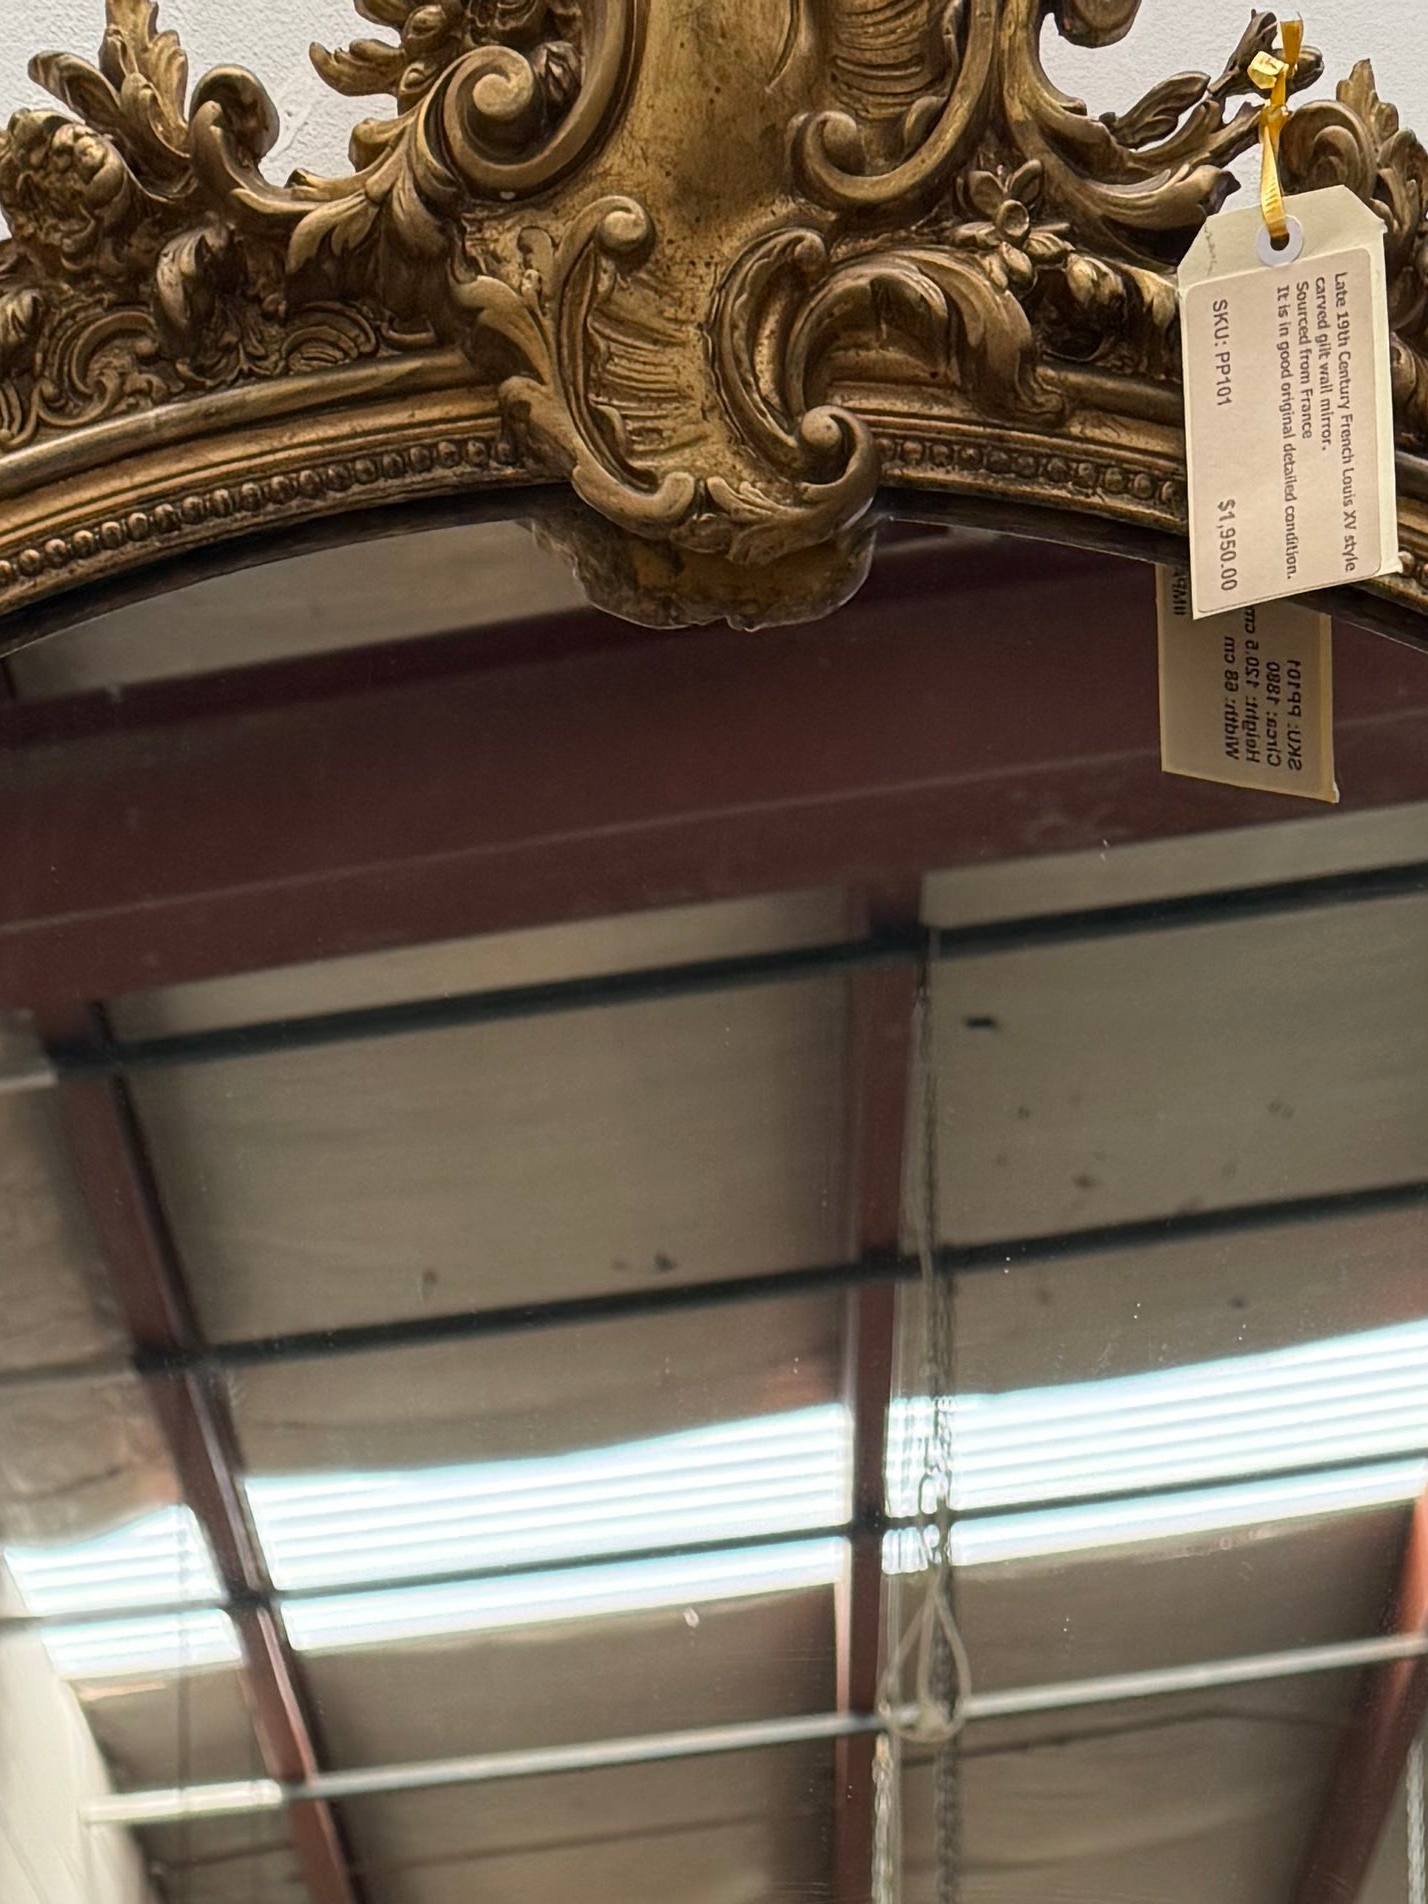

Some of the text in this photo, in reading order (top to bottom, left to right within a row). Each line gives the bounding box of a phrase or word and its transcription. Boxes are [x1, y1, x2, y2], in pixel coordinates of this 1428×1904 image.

[1213, 298, 1232, 406] SKU: PP101
[1277, 285, 1299, 580] It is in good original detailed condition.
[1296, 281, 1313, 439] Sourced from France
[1315, 277, 1334, 451] carved gilt wall mirror.
[1335, 272, 1358, 572] Late 19th Century French Louis XV style
[1216, 499, 1238, 591] $1,950.00
